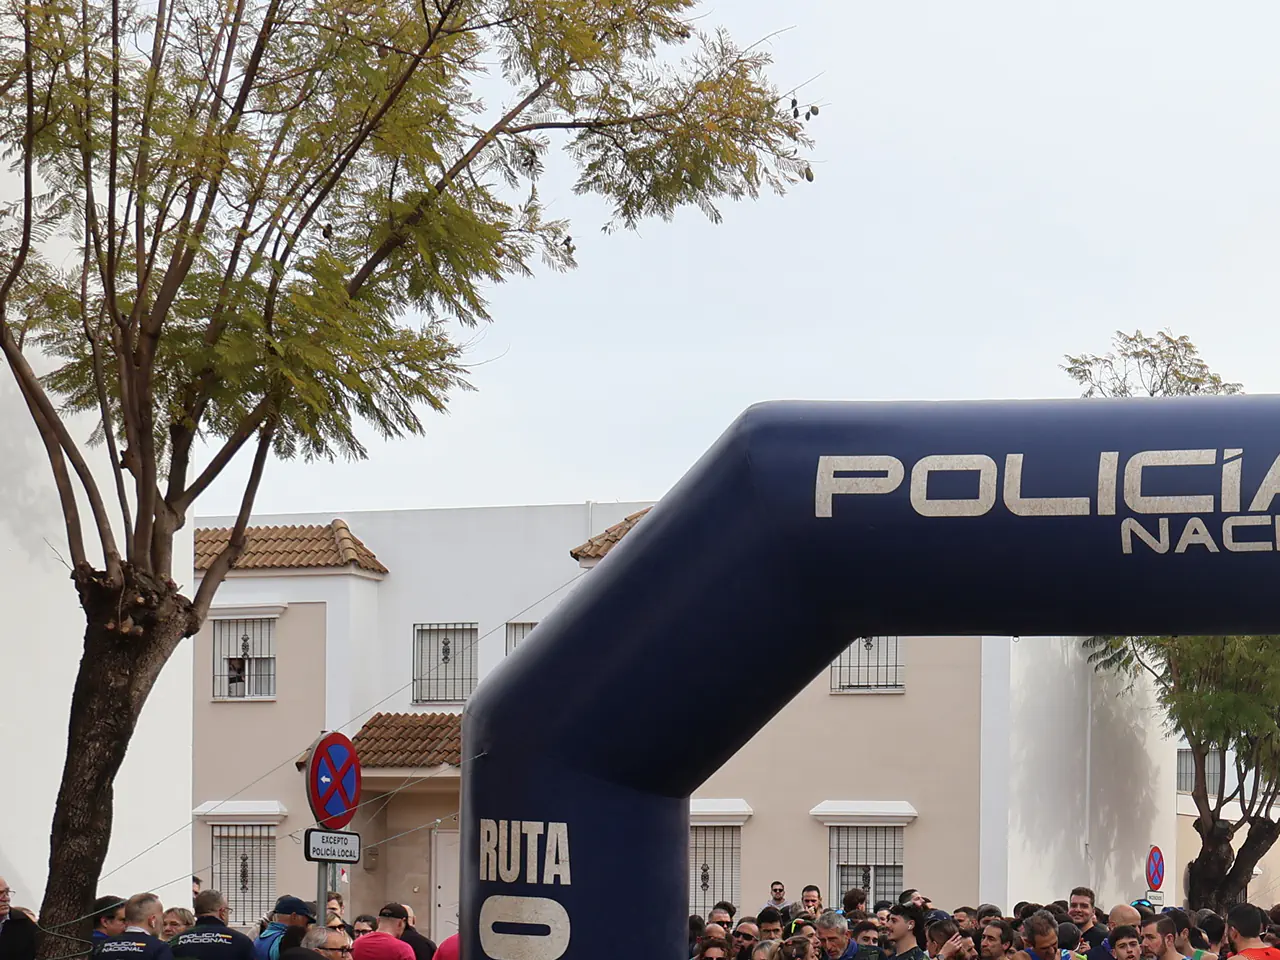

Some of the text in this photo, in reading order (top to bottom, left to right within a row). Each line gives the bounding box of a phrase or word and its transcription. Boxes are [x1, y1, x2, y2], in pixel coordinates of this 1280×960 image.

[321, 836, 349, 846] EXCEPTO
[312, 846, 357, 858] POLICÍA LOCAL
[479, 818, 572, 886] RUTA
[178, 937, 233, 945] NACIONAL
